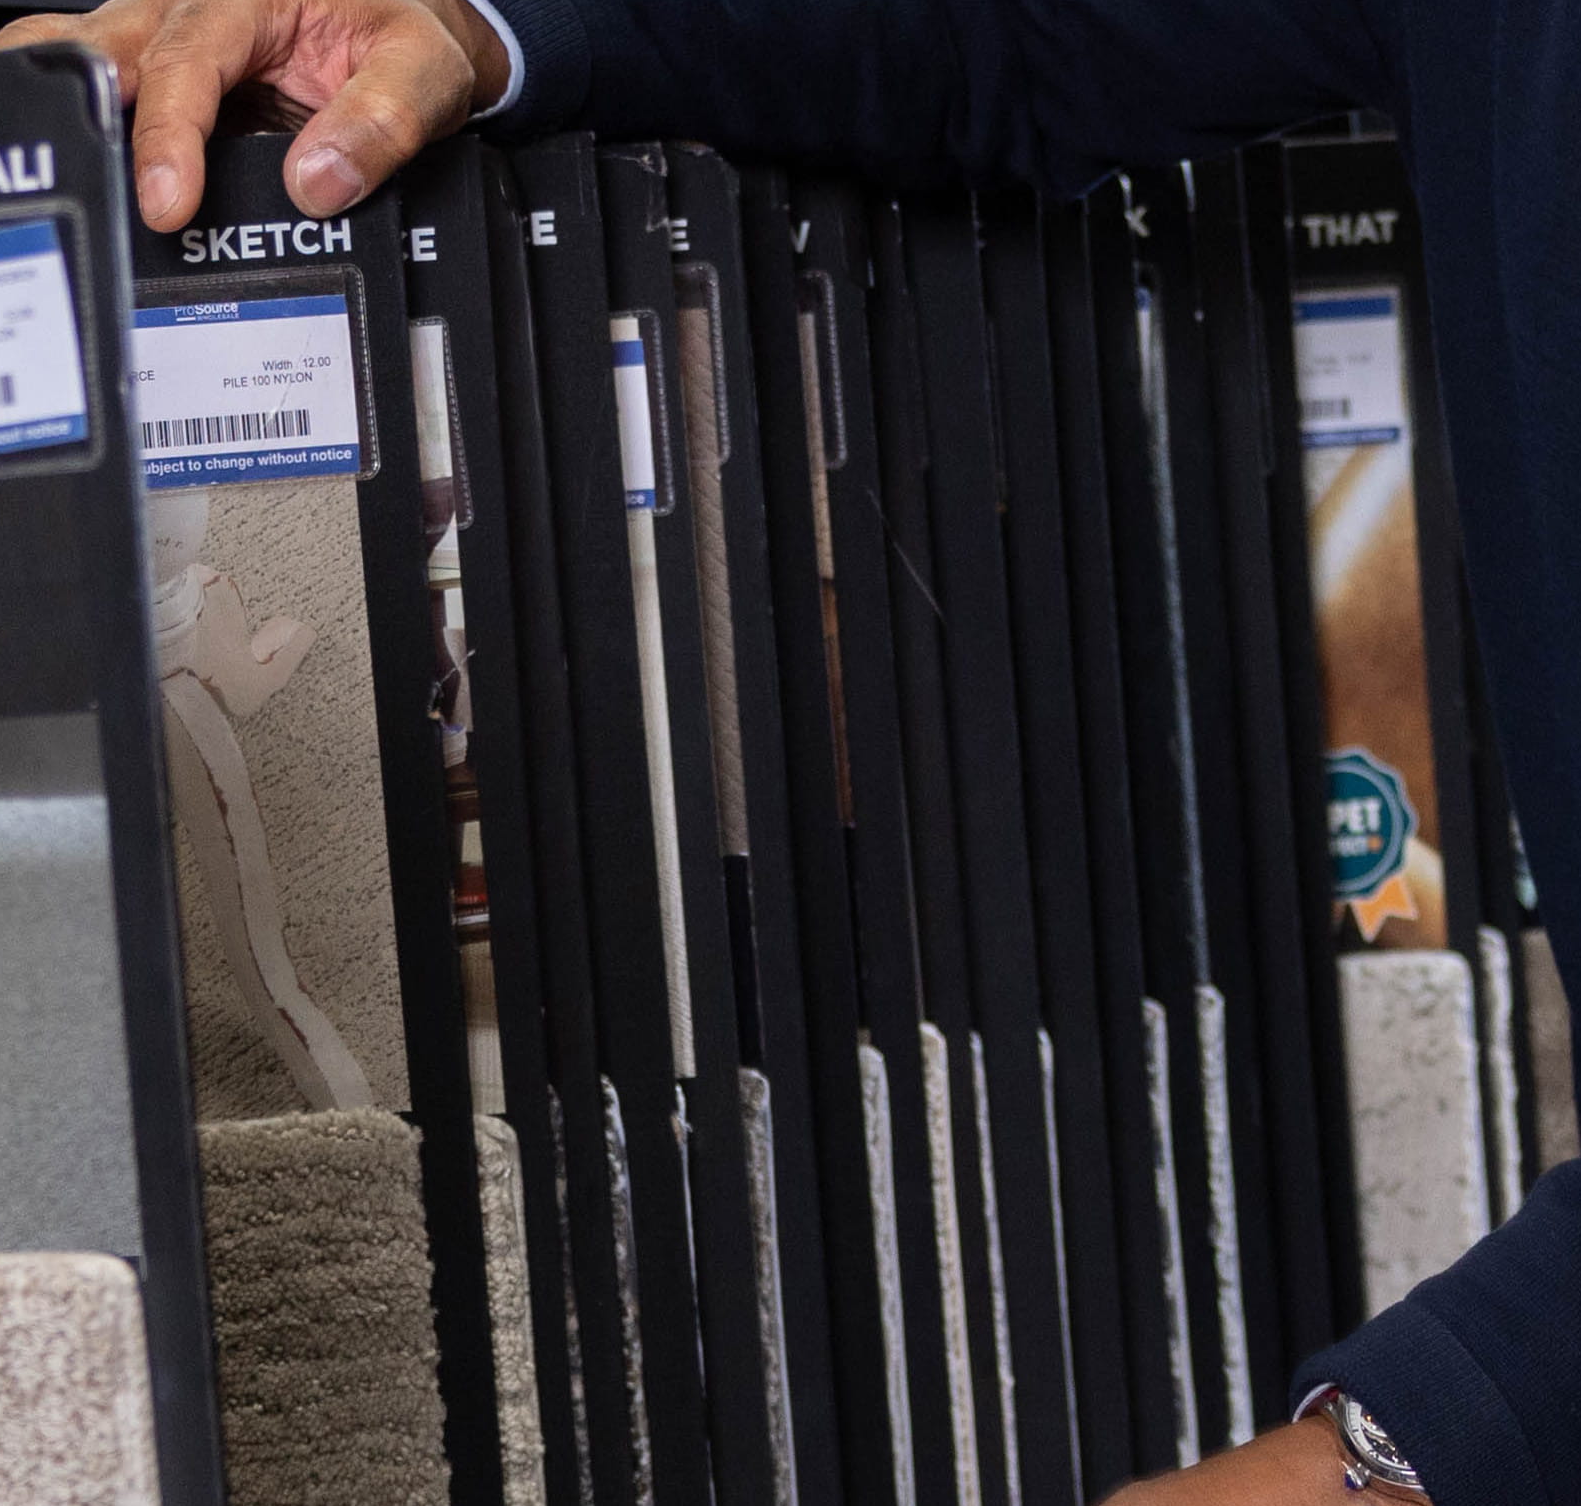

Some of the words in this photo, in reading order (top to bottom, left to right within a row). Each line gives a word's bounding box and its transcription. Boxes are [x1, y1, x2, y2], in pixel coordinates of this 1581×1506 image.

[1301, 209, 1399, 248] THAT
[181, 217, 353, 264] SKETCH
[174, 301, 239, 317] ProSource
[262, 359, 293, 372] Width
[303, 356, 331, 369] 12.00
[223, 375, 249, 389] PILE
[252, 373, 271, 387] 100
[273, 370, 314, 386] NYLON
[188, 457, 203, 472] to
[205, 455, 256, 472] change
[257, 450, 309, 467] without
[310, 447, 353, 463] notice
